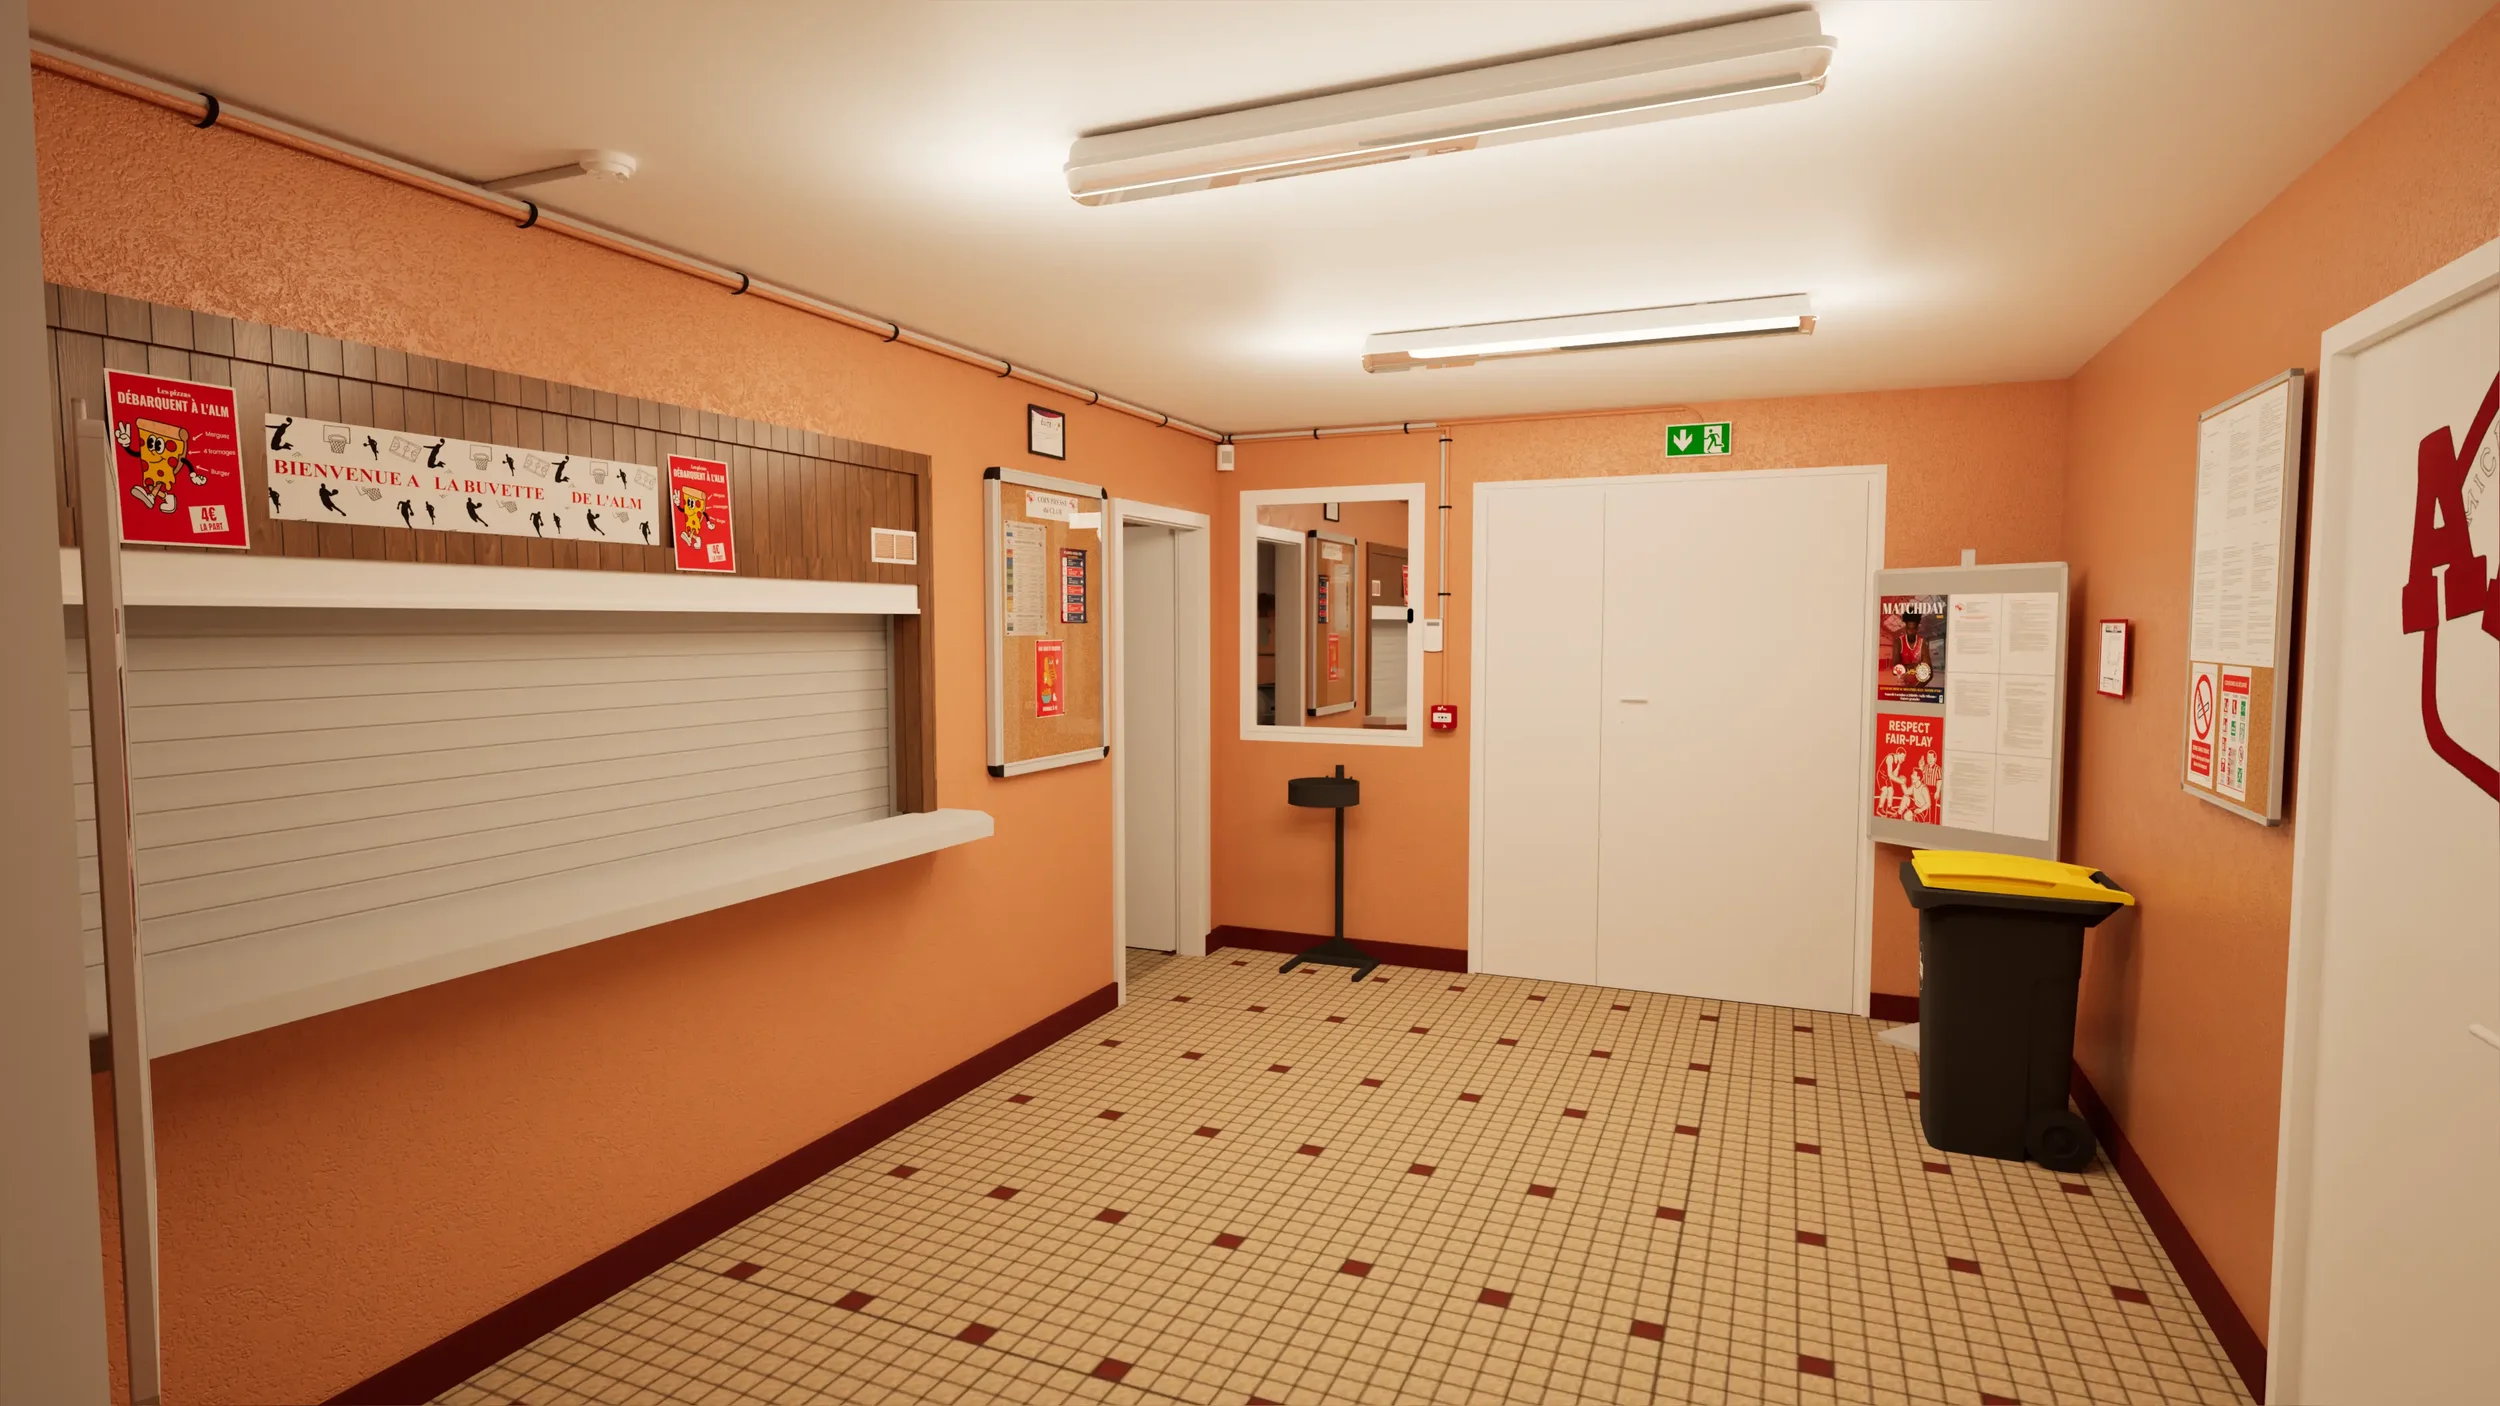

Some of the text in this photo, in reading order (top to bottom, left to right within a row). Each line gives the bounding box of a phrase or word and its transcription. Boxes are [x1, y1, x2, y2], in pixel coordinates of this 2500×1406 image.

[169, 389, 191, 398] pizzas
[117, 389, 229, 418] DÉBARQUENT À L'ALM
[205, 431, 230, 440] Merguez
[210, 469, 230, 477] Burger
[274, 458, 643, 510] BIENVENUE A LA BUVETTE DE L'ALM
[201, 506, 217, 521] 4€
[208, 522, 223, 531] PART
[1882, 601, 1946, 615] MATCHDAY
[1888, 720, 1931, 734] RESPECT
[1885, 732, 1933, 748] FAIR-PLAY
